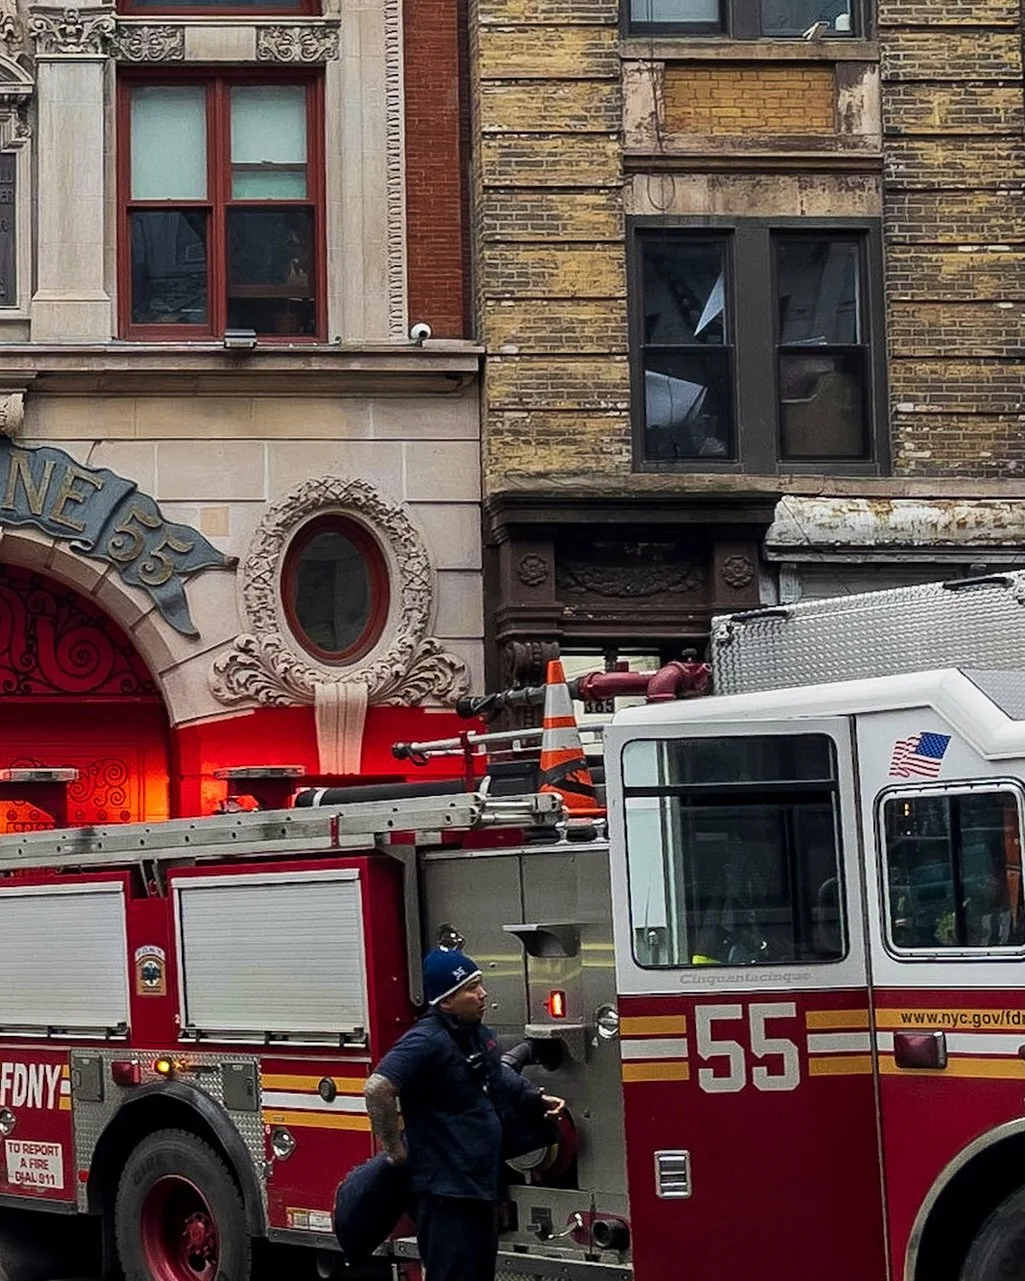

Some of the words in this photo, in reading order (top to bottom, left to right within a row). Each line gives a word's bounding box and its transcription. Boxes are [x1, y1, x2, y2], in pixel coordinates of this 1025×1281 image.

[107, 505, 195, 587] 55
[694, 1001, 801, 1094] 55
[0, 1061, 61, 1110] FDNY
[7, 1142, 21, 1153] TO
[22, 1142, 59, 1156] REPORT
[20, 1158, 28, 1169] A
[29, 1159, 49, 1170] FIRE
[15, 1171, 37, 1183] DIAL
[39, 1173, 55, 1185] 911
